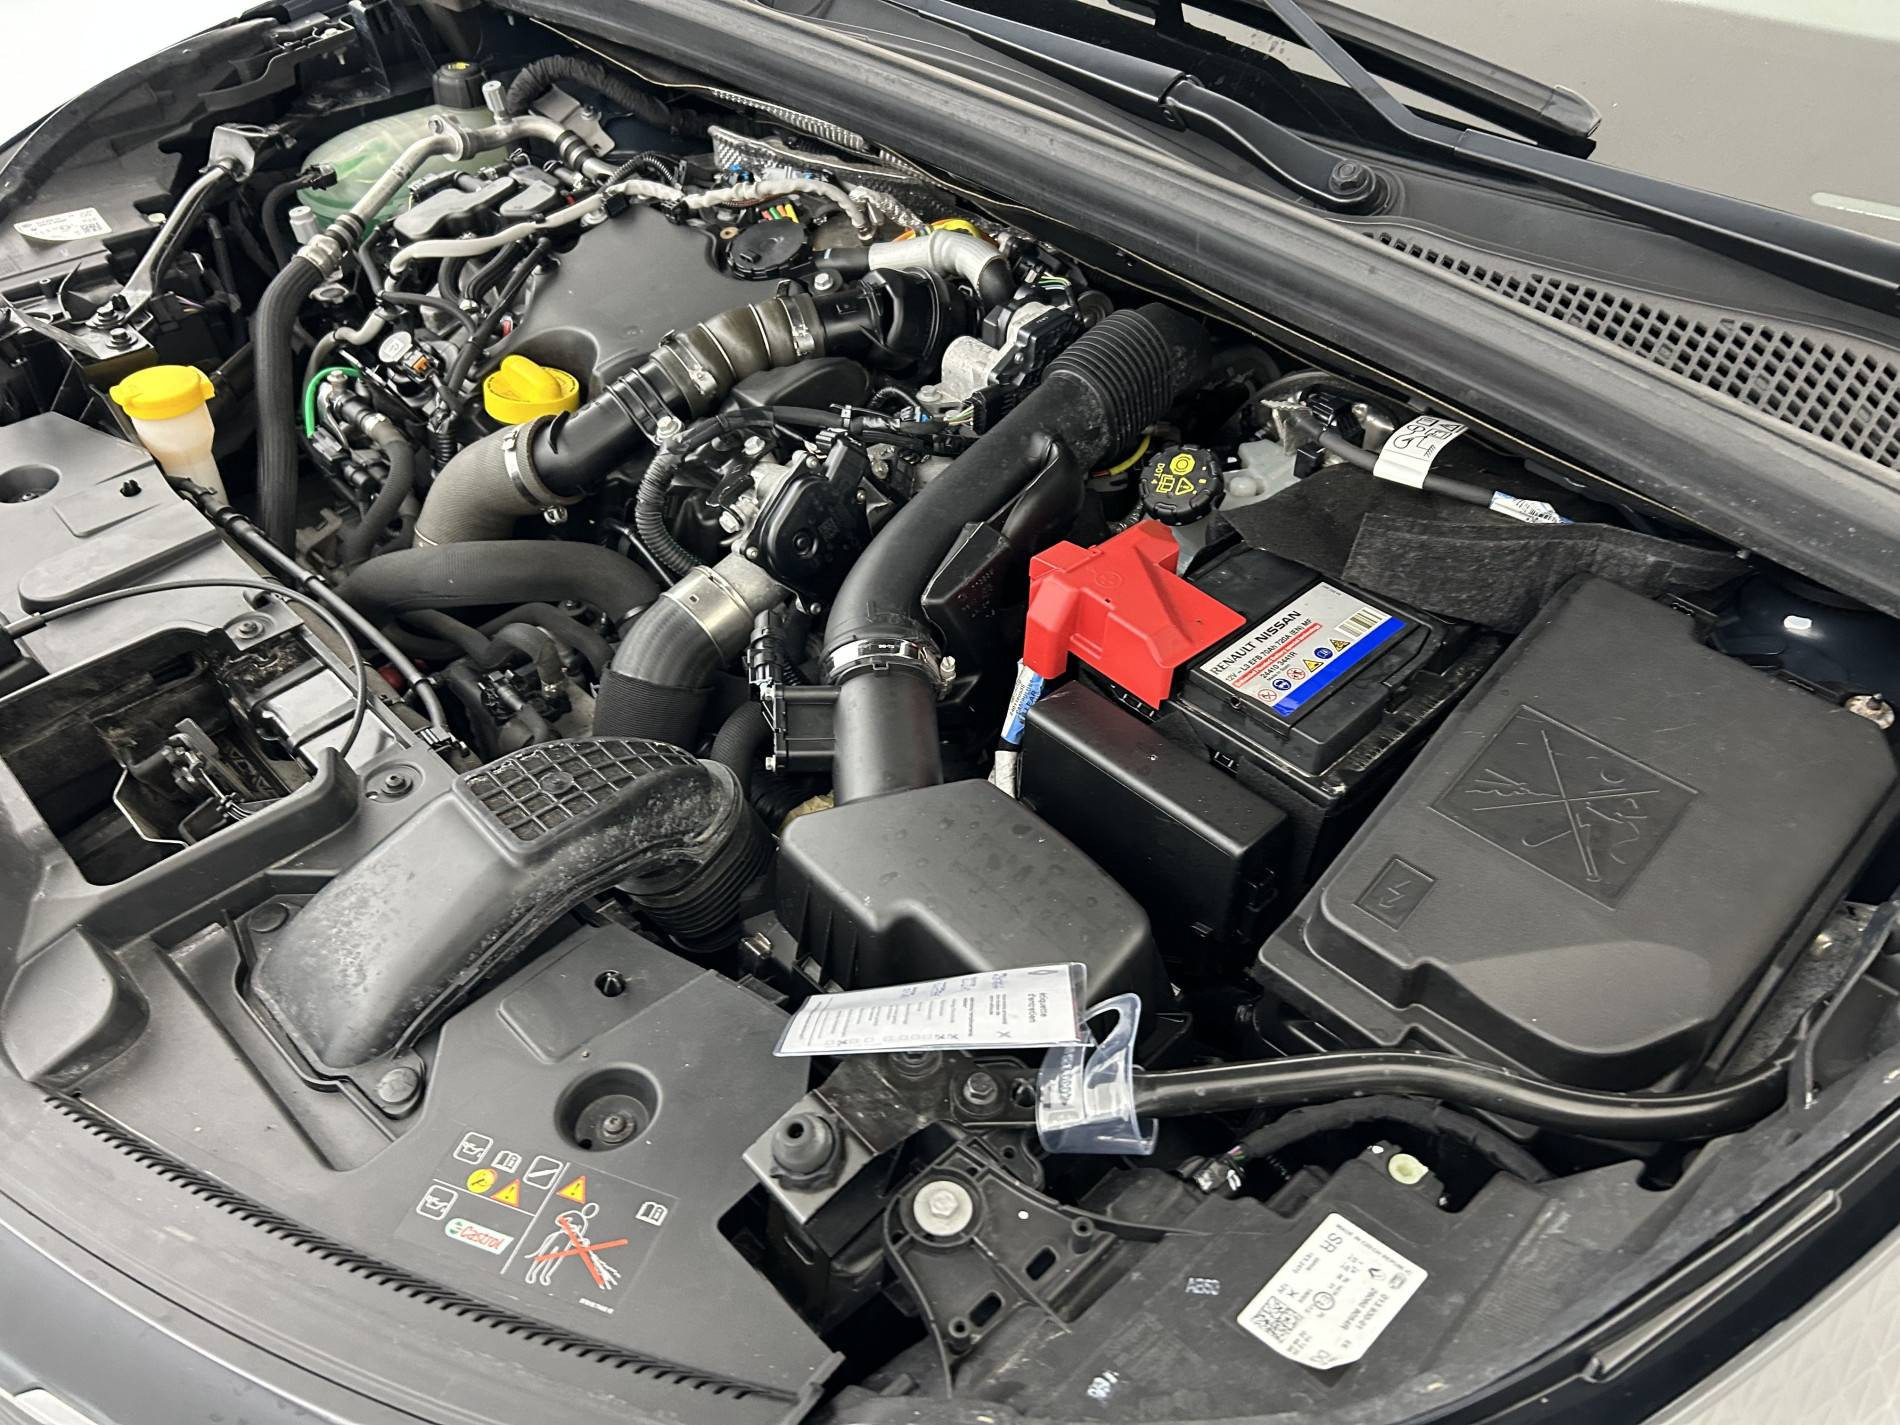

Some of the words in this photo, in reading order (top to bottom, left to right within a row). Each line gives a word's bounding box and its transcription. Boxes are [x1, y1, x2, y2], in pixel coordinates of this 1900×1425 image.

[1154, 463, 1165, 478] DOT
[1209, 641, 1256, 675] RENAULT
[1255, 611, 1301, 643] NISSAN
[1260, 664, 1279, 678] 24410
[460, 1226, 505, 1249] Castrol
[1320, 1233, 1343, 1253] SR
